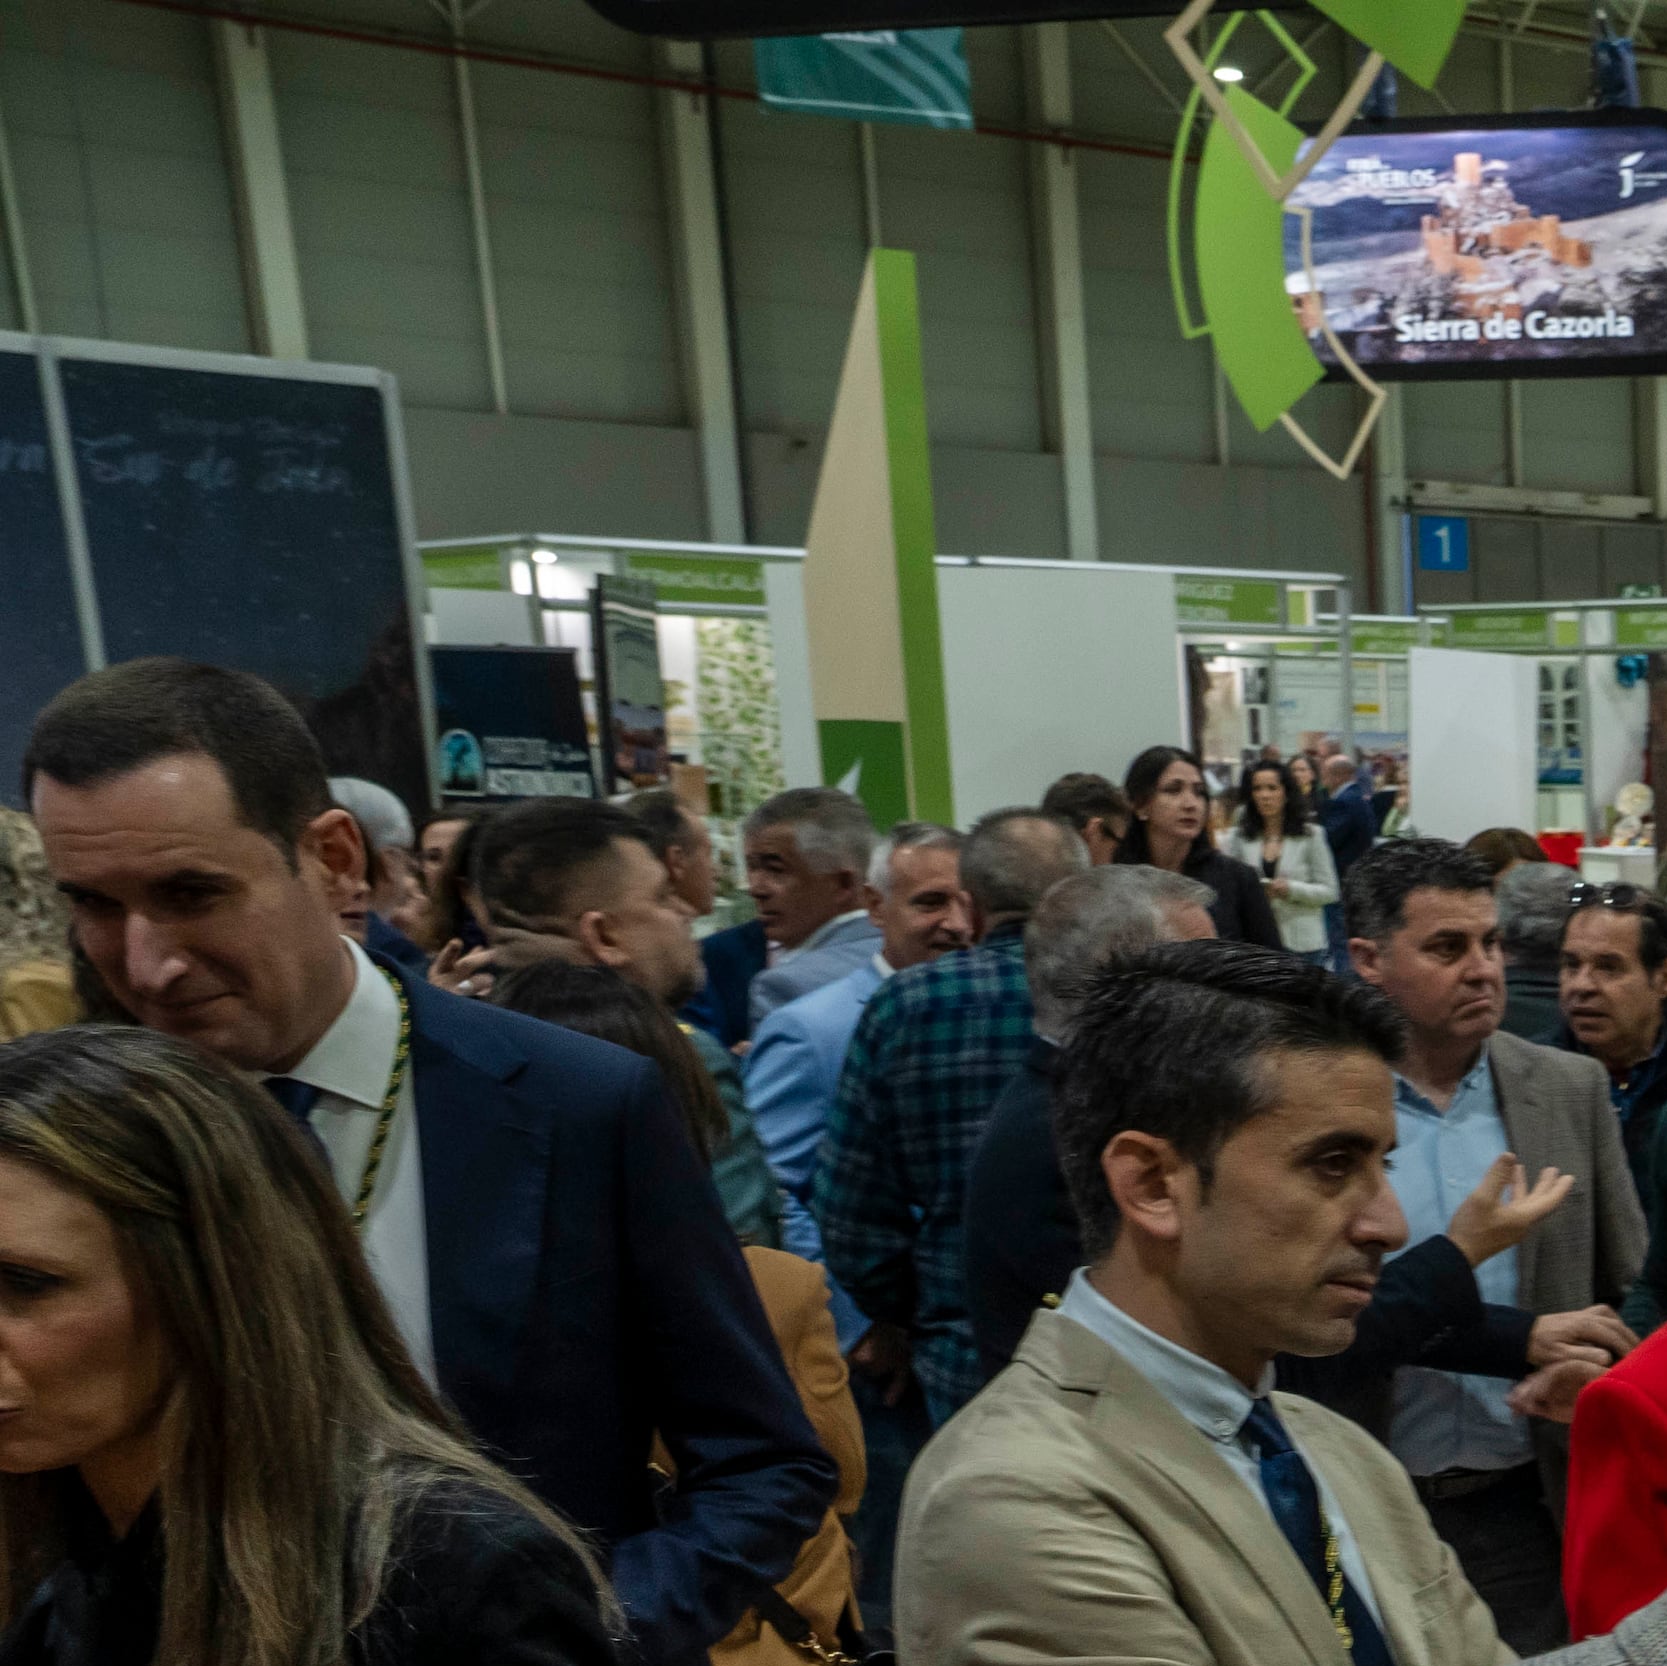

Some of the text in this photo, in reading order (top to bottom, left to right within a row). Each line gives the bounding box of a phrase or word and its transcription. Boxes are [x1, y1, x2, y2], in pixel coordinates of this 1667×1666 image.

[1395, 309, 1634, 342] Sierra de Cazorla
[1434, 525, 1452, 563] 1
